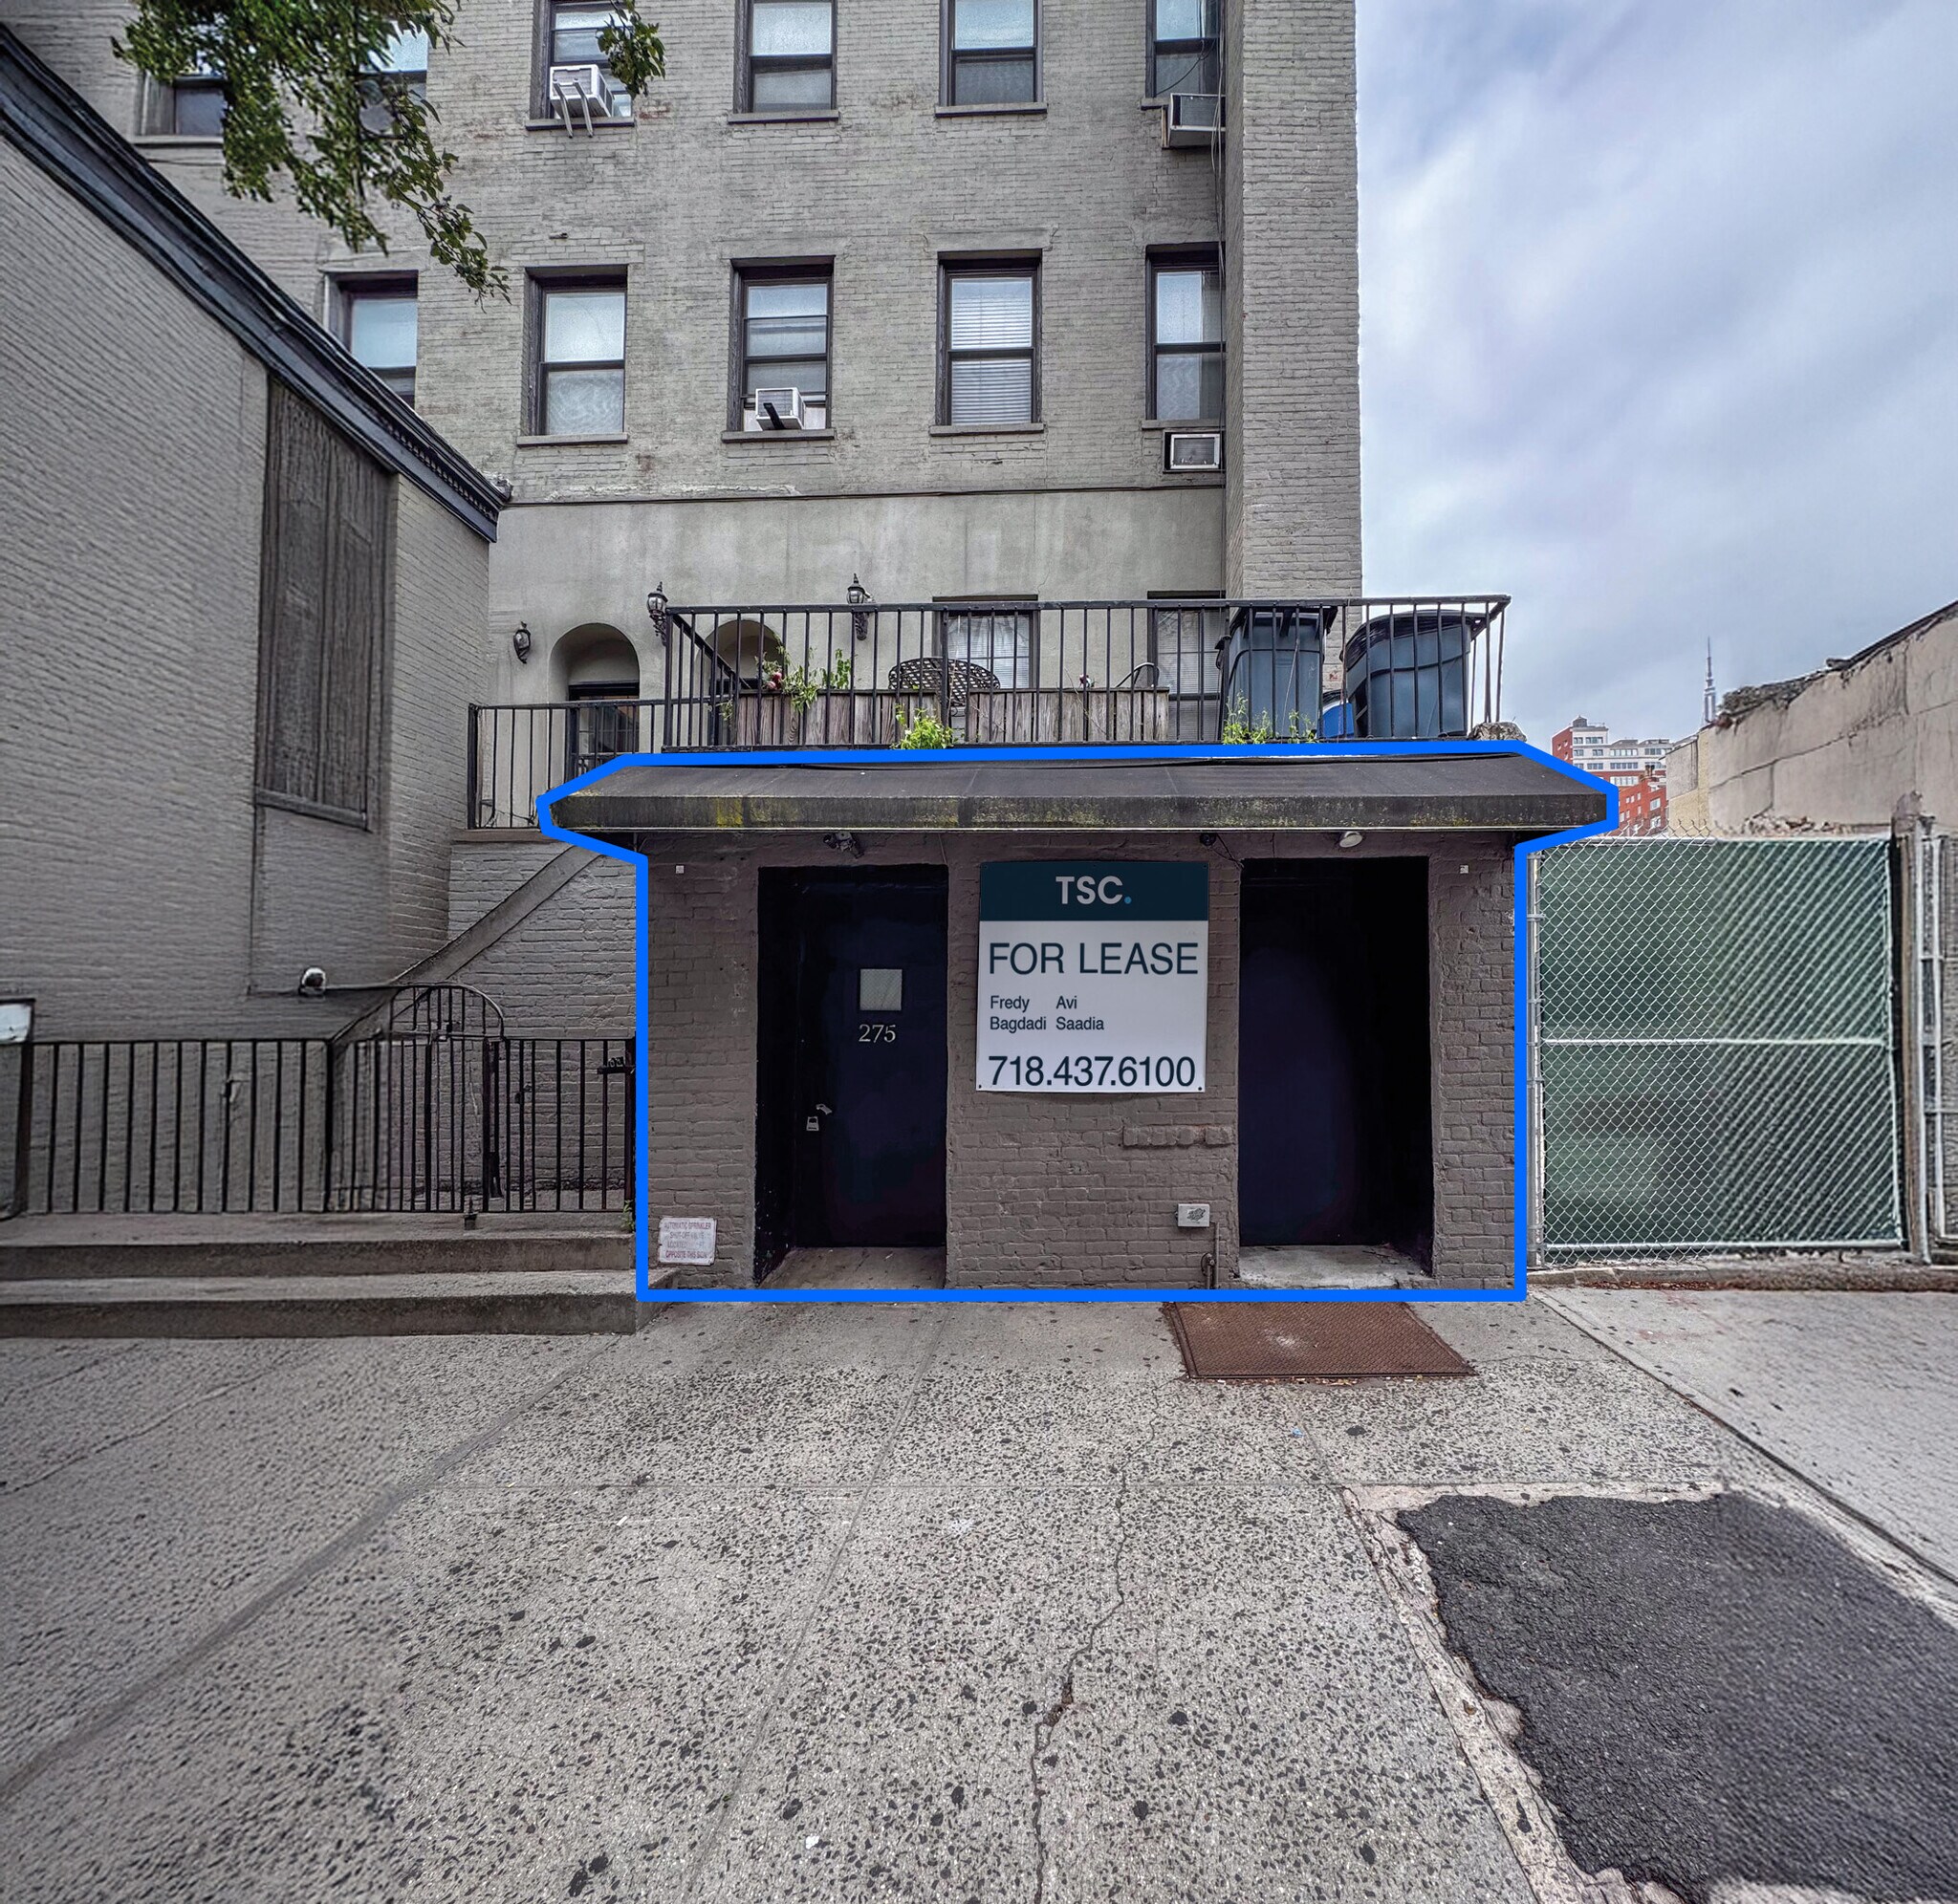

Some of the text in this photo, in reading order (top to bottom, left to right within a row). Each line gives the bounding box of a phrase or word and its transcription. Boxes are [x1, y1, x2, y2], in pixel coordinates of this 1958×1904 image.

[1055, 876, 1132, 905] TSC.
[990, 942, 1198, 975] FOR LEASE
[990, 995, 1030, 1013] Fredy
[1055, 995, 1077, 1009] Avi
[990, 1016, 1046, 1033] Bagdadi
[1055, 1016, 1104, 1030] Saadia
[859, 1024, 896, 1043] 275
[989, 1056, 1195, 1087] 718.437.6100
